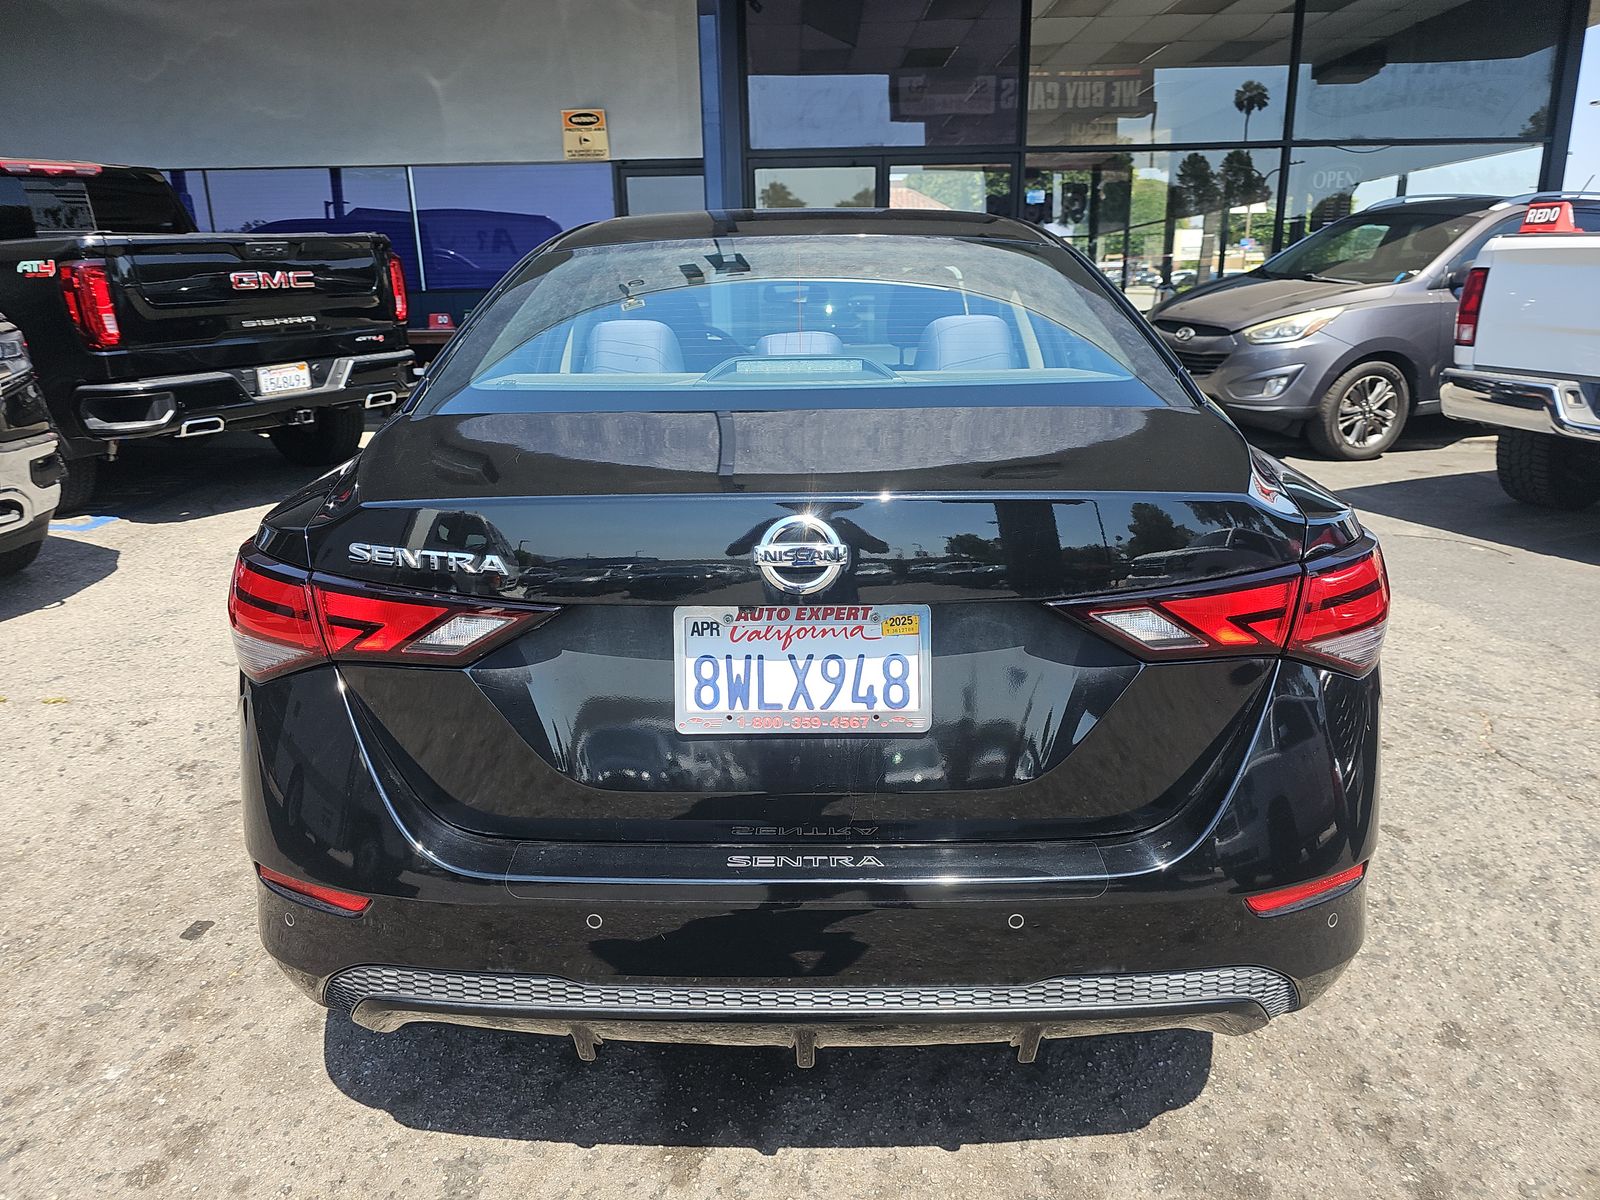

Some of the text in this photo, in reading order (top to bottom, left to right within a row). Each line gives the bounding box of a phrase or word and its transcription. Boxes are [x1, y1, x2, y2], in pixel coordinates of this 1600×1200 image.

[1313, 170, 1358, 189] OPEN
[1525, 206, 1561, 223] REDO
[16, 259, 57, 278] AT4
[229, 271, 316, 290] GMC
[241, 315, 317, 328] SIERRA
[348, 542, 509, 576] SENTRA
[763, 546, 840, 563] NISSAN
[735, 606, 873, 622] AUTO EXPERT
[889, 615, 913, 627] 2025
[690, 621, 721, 637] APR
[729, 625, 882, 651] California
[693, 653, 911, 711] 8WLX948
[736, 715, 870, 729] 1-800-359-4567
[726, 855, 885, 868] SENTRA
